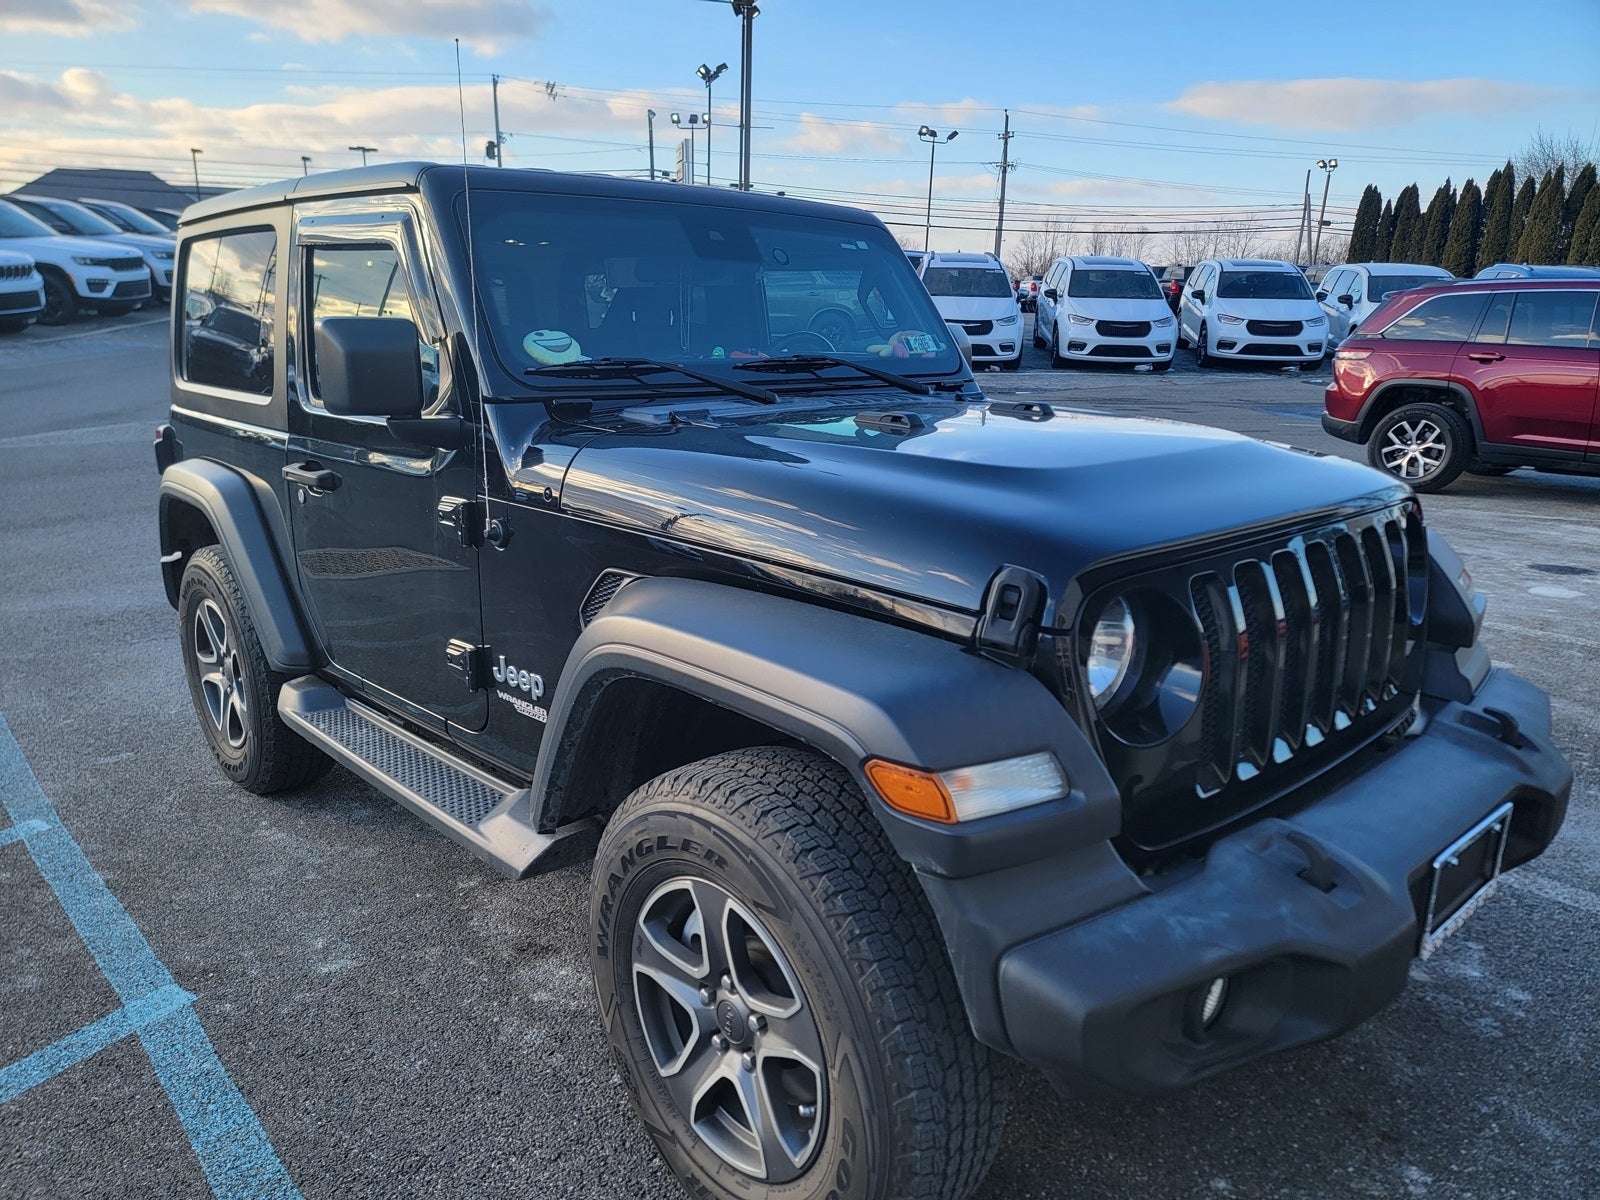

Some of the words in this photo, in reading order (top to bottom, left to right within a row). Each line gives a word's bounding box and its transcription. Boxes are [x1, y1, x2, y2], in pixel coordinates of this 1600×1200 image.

[492, 655, 545, 701] Jeep
[496, 689, 549, 718] WRANGLER
[596, 835, 729, 960] WRANGLER
